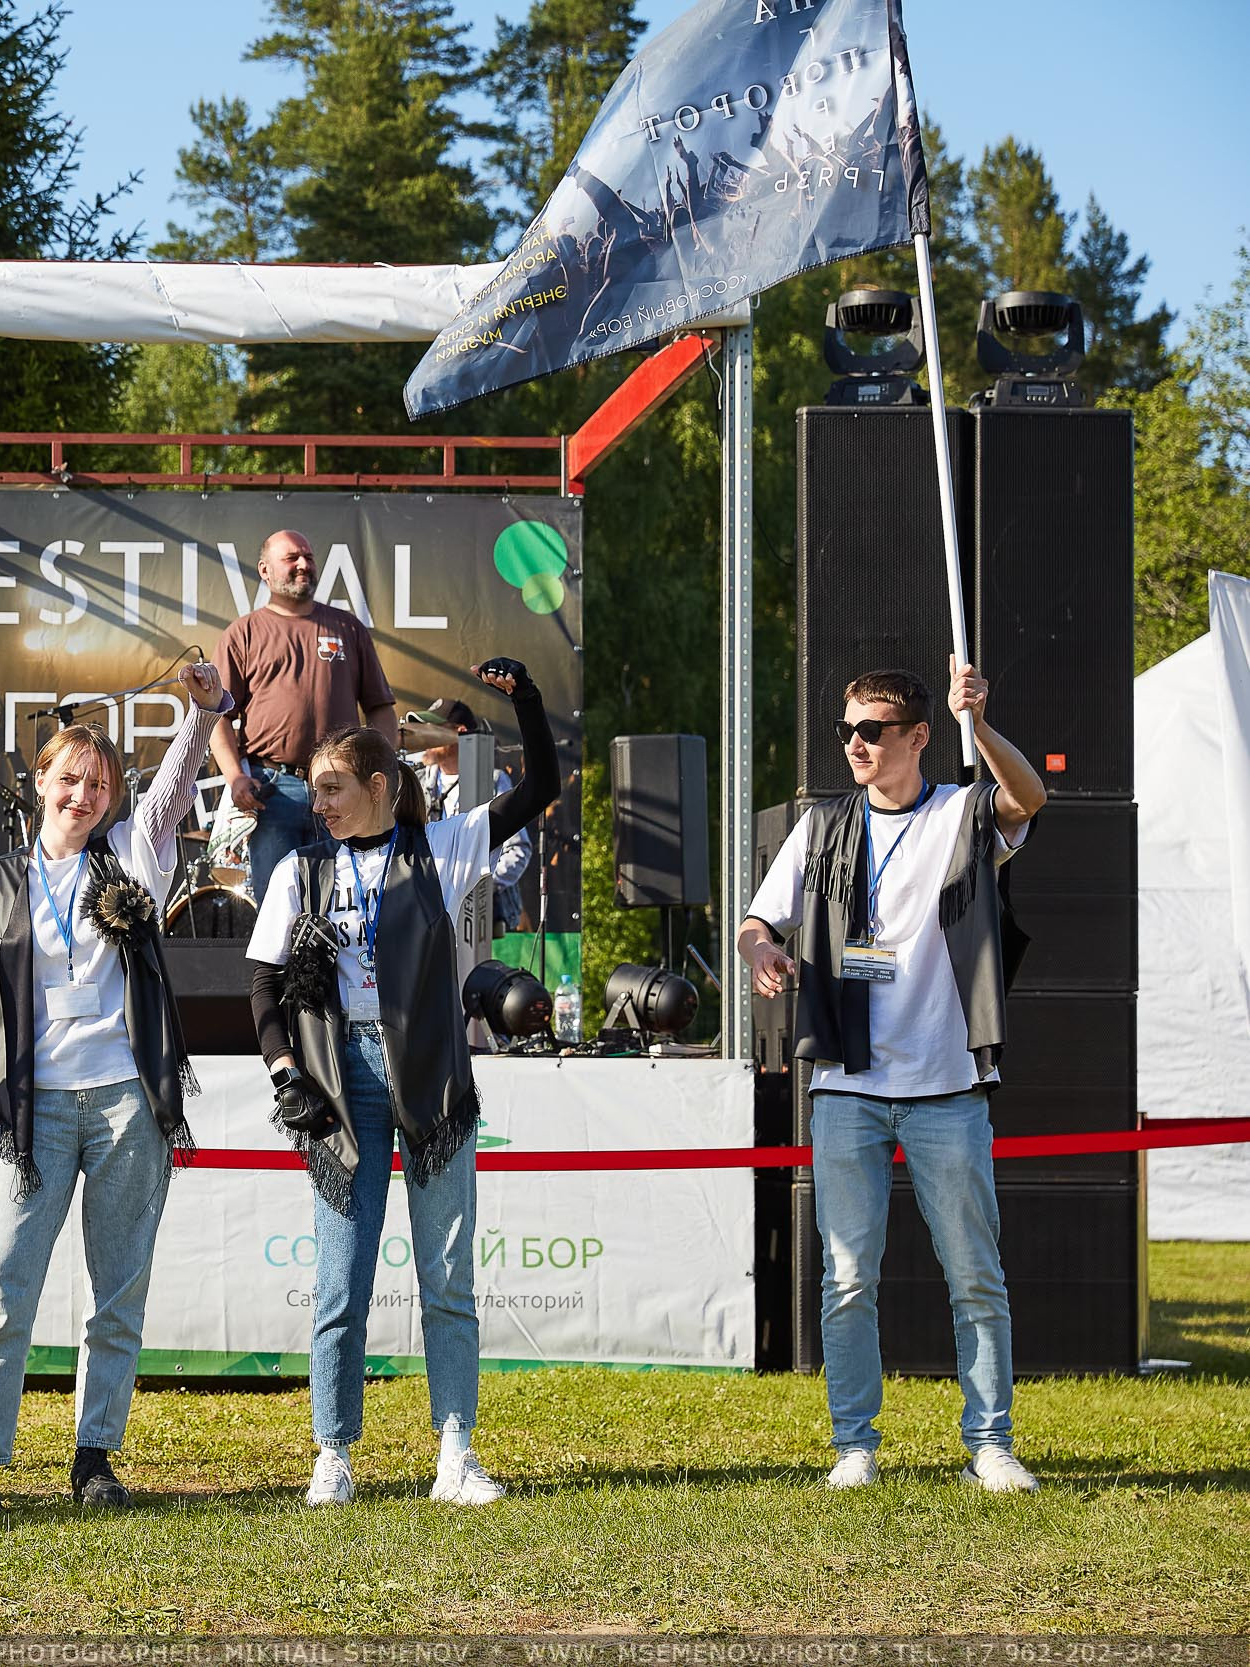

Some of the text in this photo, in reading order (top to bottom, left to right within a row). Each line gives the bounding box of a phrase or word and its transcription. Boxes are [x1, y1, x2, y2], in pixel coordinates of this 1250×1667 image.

[4, 692, 186, 754] ГОР
[264, 1229, 604, 1269] СООЙ БОР
